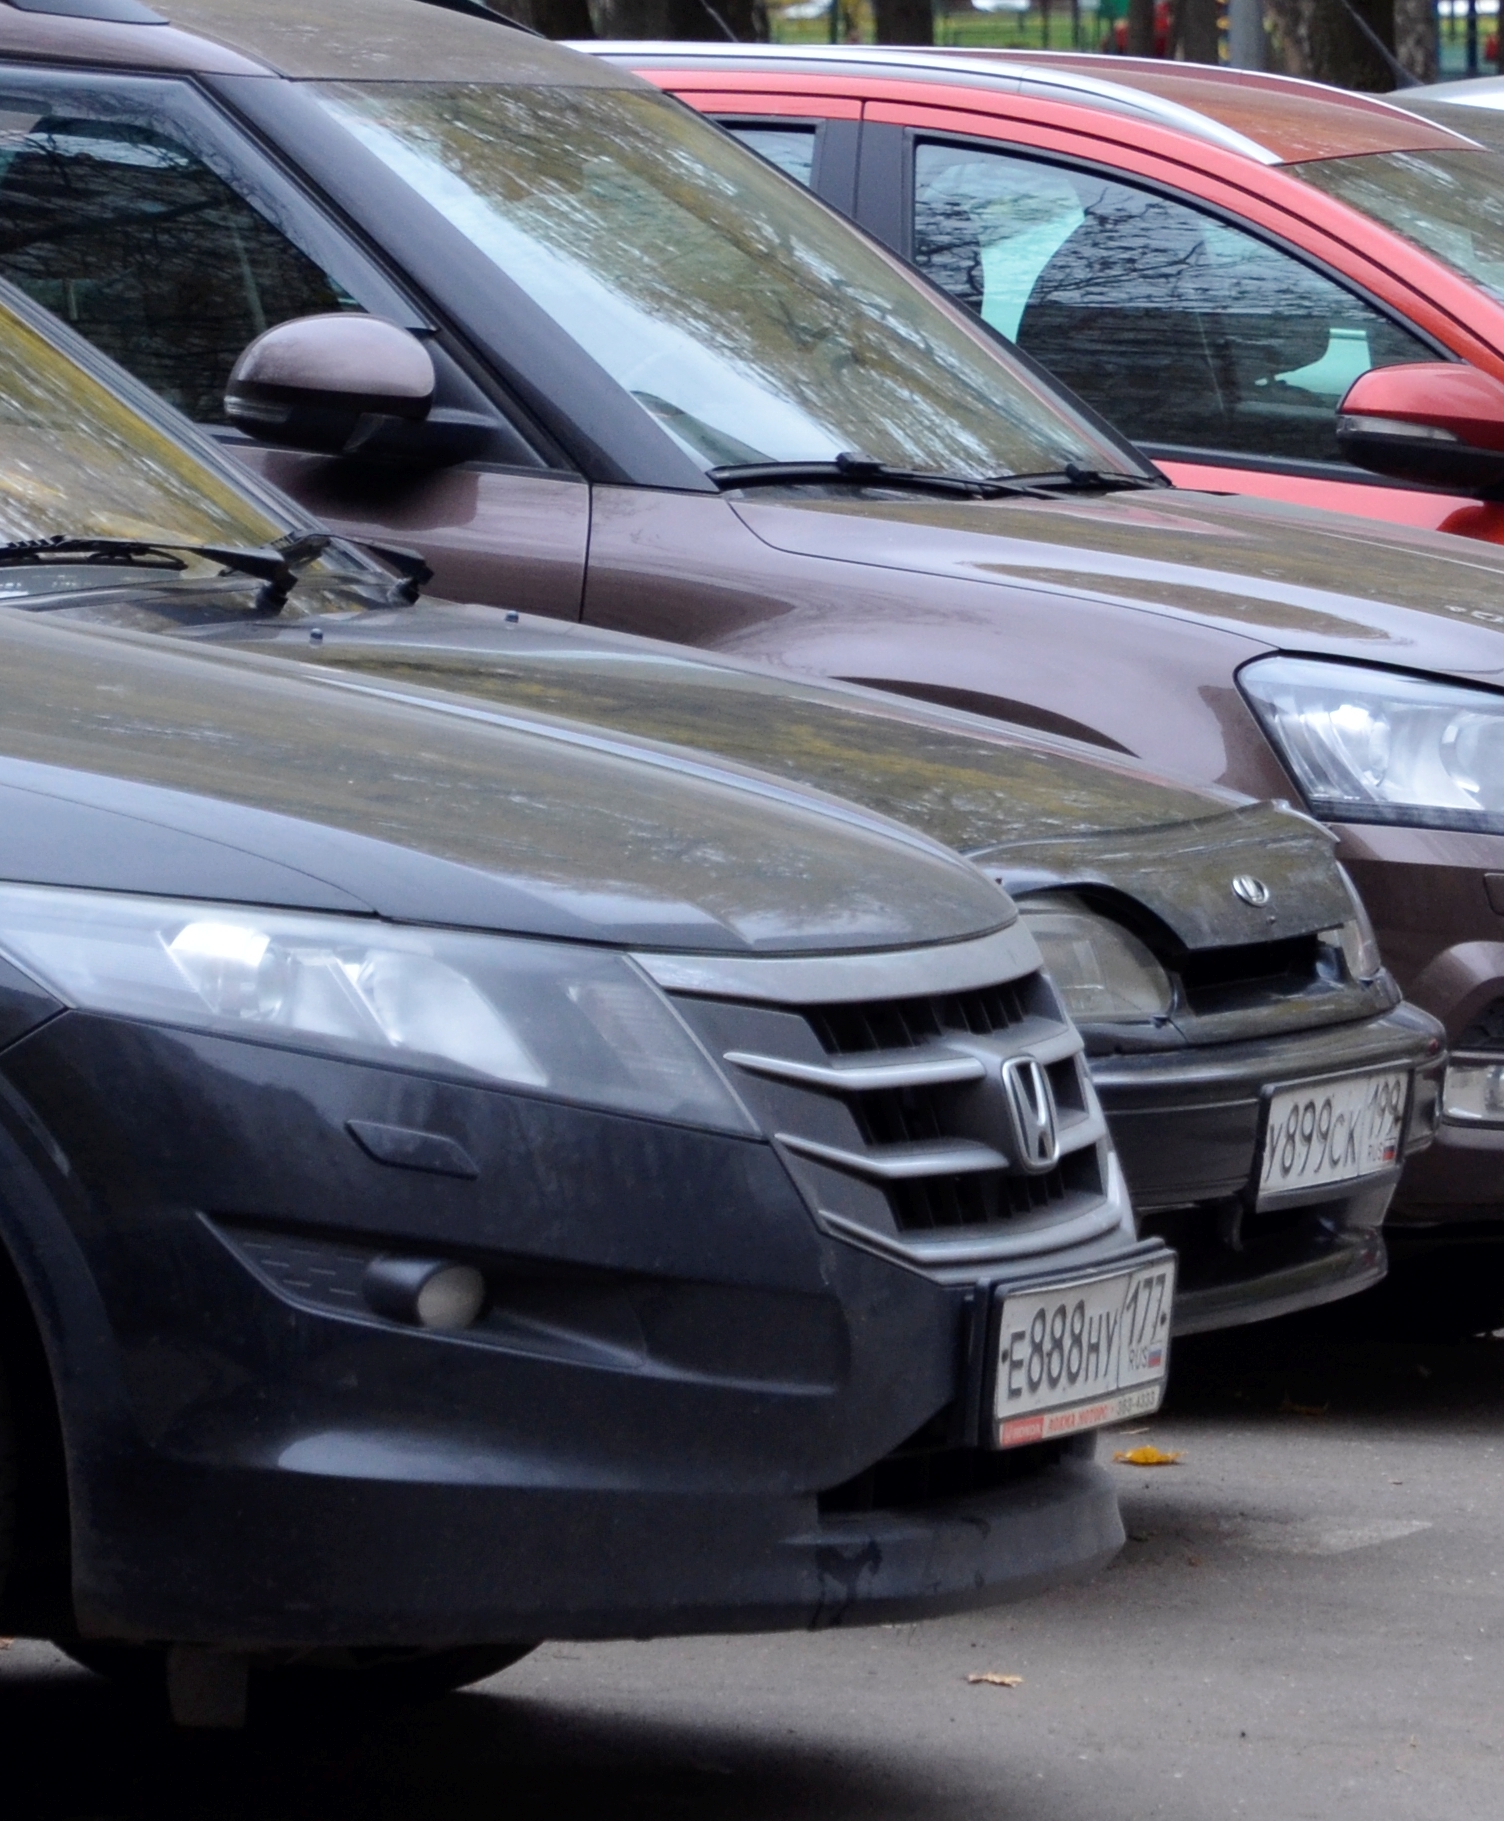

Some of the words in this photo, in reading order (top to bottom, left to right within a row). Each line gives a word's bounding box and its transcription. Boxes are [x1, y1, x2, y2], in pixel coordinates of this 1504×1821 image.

[1367, 1078, 1402, 1139] 199
[1126, 1273, 1167, 1346] 177
[1129, 1346, 1148, 1371] RUS
